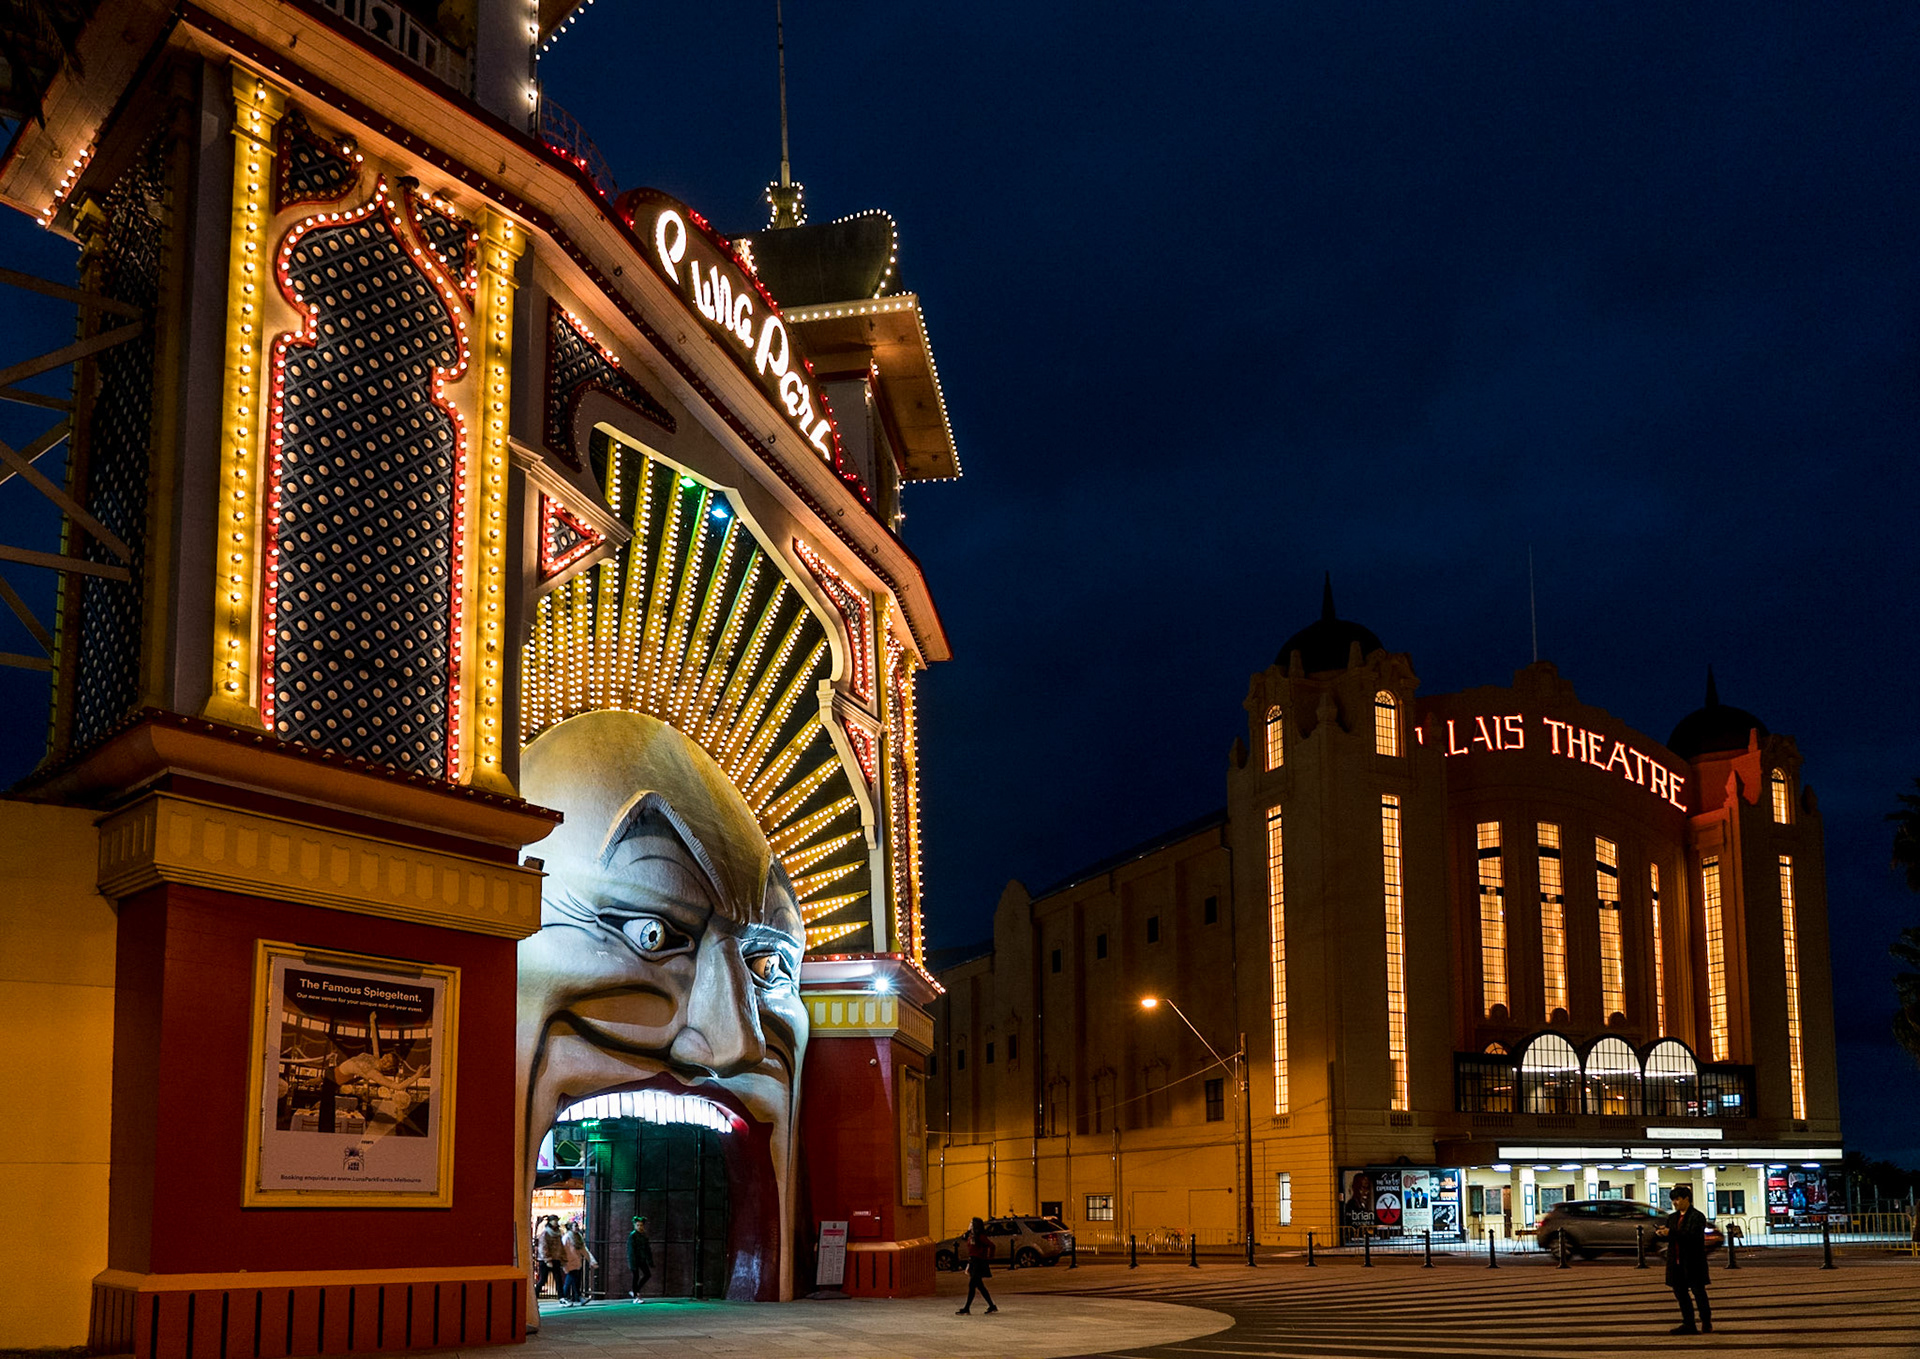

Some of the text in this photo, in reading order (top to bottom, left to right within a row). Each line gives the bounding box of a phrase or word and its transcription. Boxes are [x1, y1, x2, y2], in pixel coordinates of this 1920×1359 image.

[1543, 717, 1687, 813] THEATRE
[299, 978, 422, 1003] The Famous Spiegeltent.
[280, 1174, 303, 1182] Booking
[1351, 1209, 1375, 1221] brian
